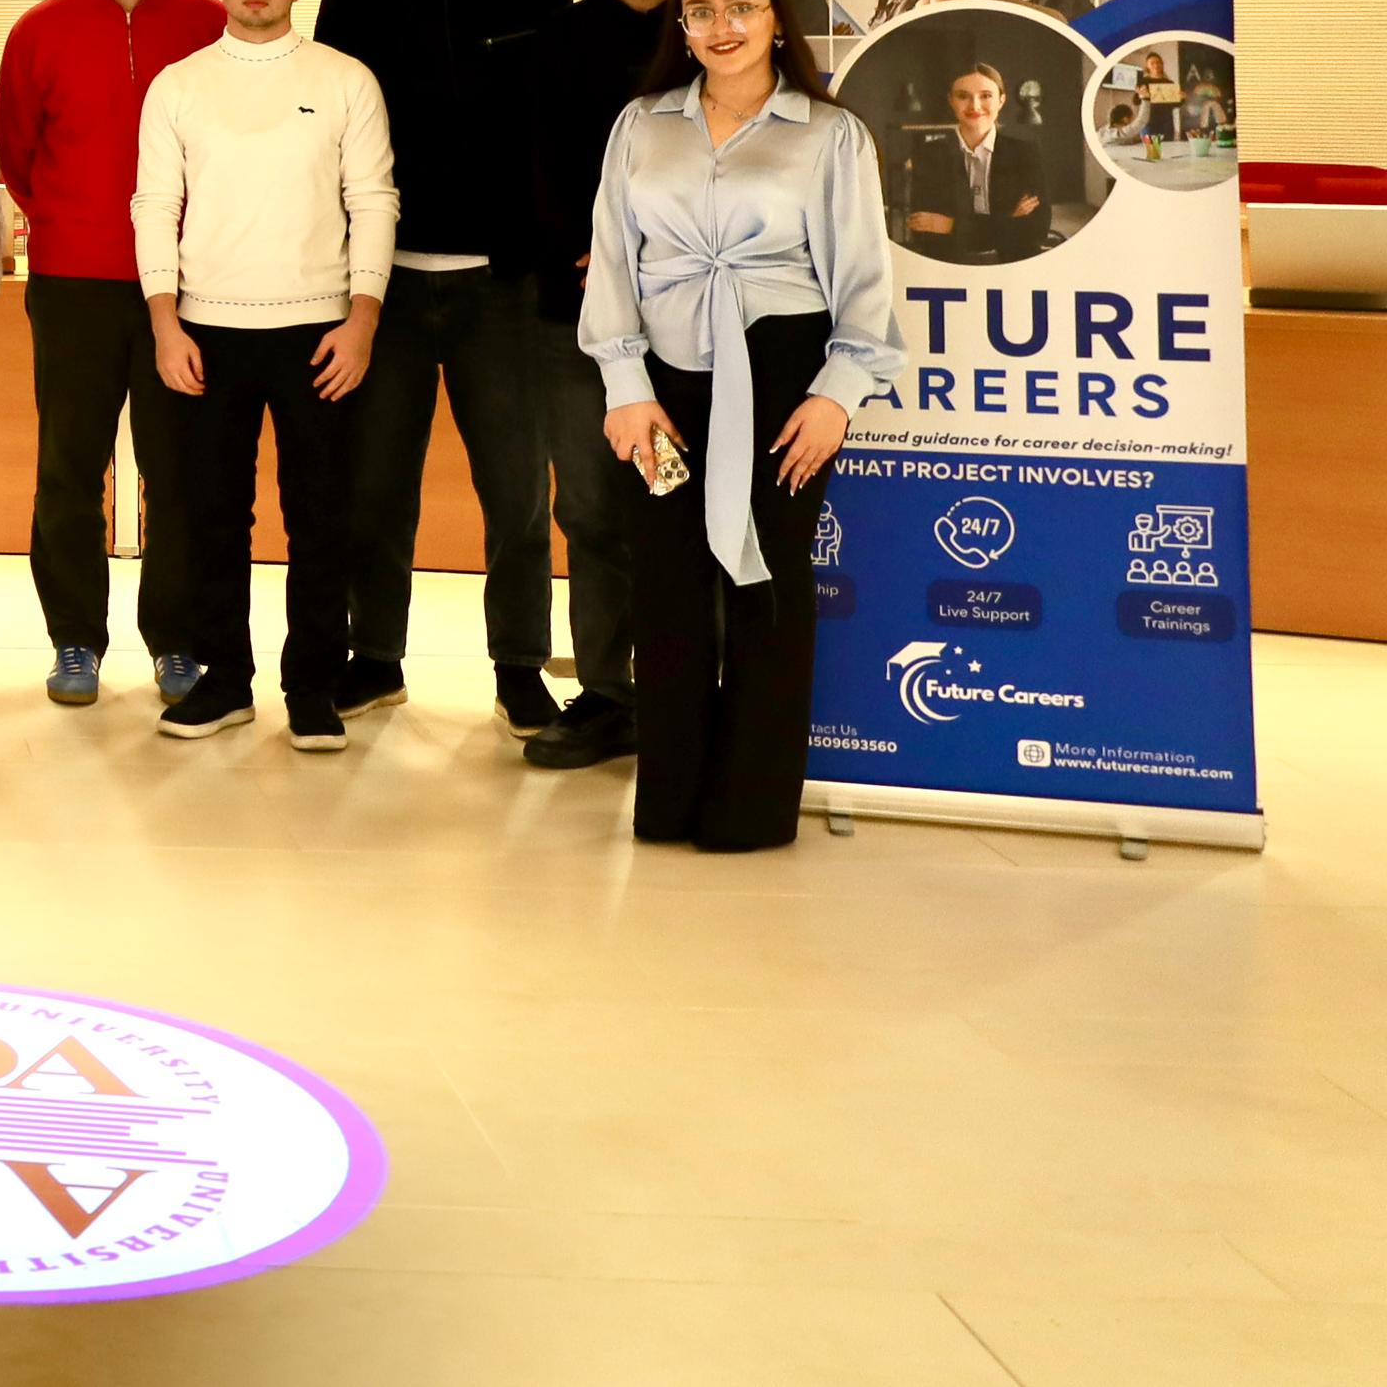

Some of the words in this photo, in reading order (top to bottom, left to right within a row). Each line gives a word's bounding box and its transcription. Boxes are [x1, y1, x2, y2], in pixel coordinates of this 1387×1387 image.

[906, 287, 1211, 362] TURE
[912, 432, 990, 446] guidance
[994, 435, 1019, 448] for
[1023, 439, 1079, 451] career
[1082, 438, 1233, 459] decision-making!
[902, 461, 1012, 482] PROJECT
[1018, 466, 1155, 488] INVOLVES?
[961, 518, 1001, 536] 24/7
[966, 590, 1002, 604] 24/7
[939, 605, 968, 618] Live
[972, 606, 1030, 623] Support
[1150, 601, 1201, 616] Career
[1142, 616, 1210, 635] Trainings
[927, 679, 994, 702] Future
[998, 684, 1084, 708] Careers
[840, 724, 857, 736] Us
[1055, 743, 1096, 756] More
[1102, 746, 1195, 763] Information
[1053, 758, 1233, 780] www.futurecareers.com
